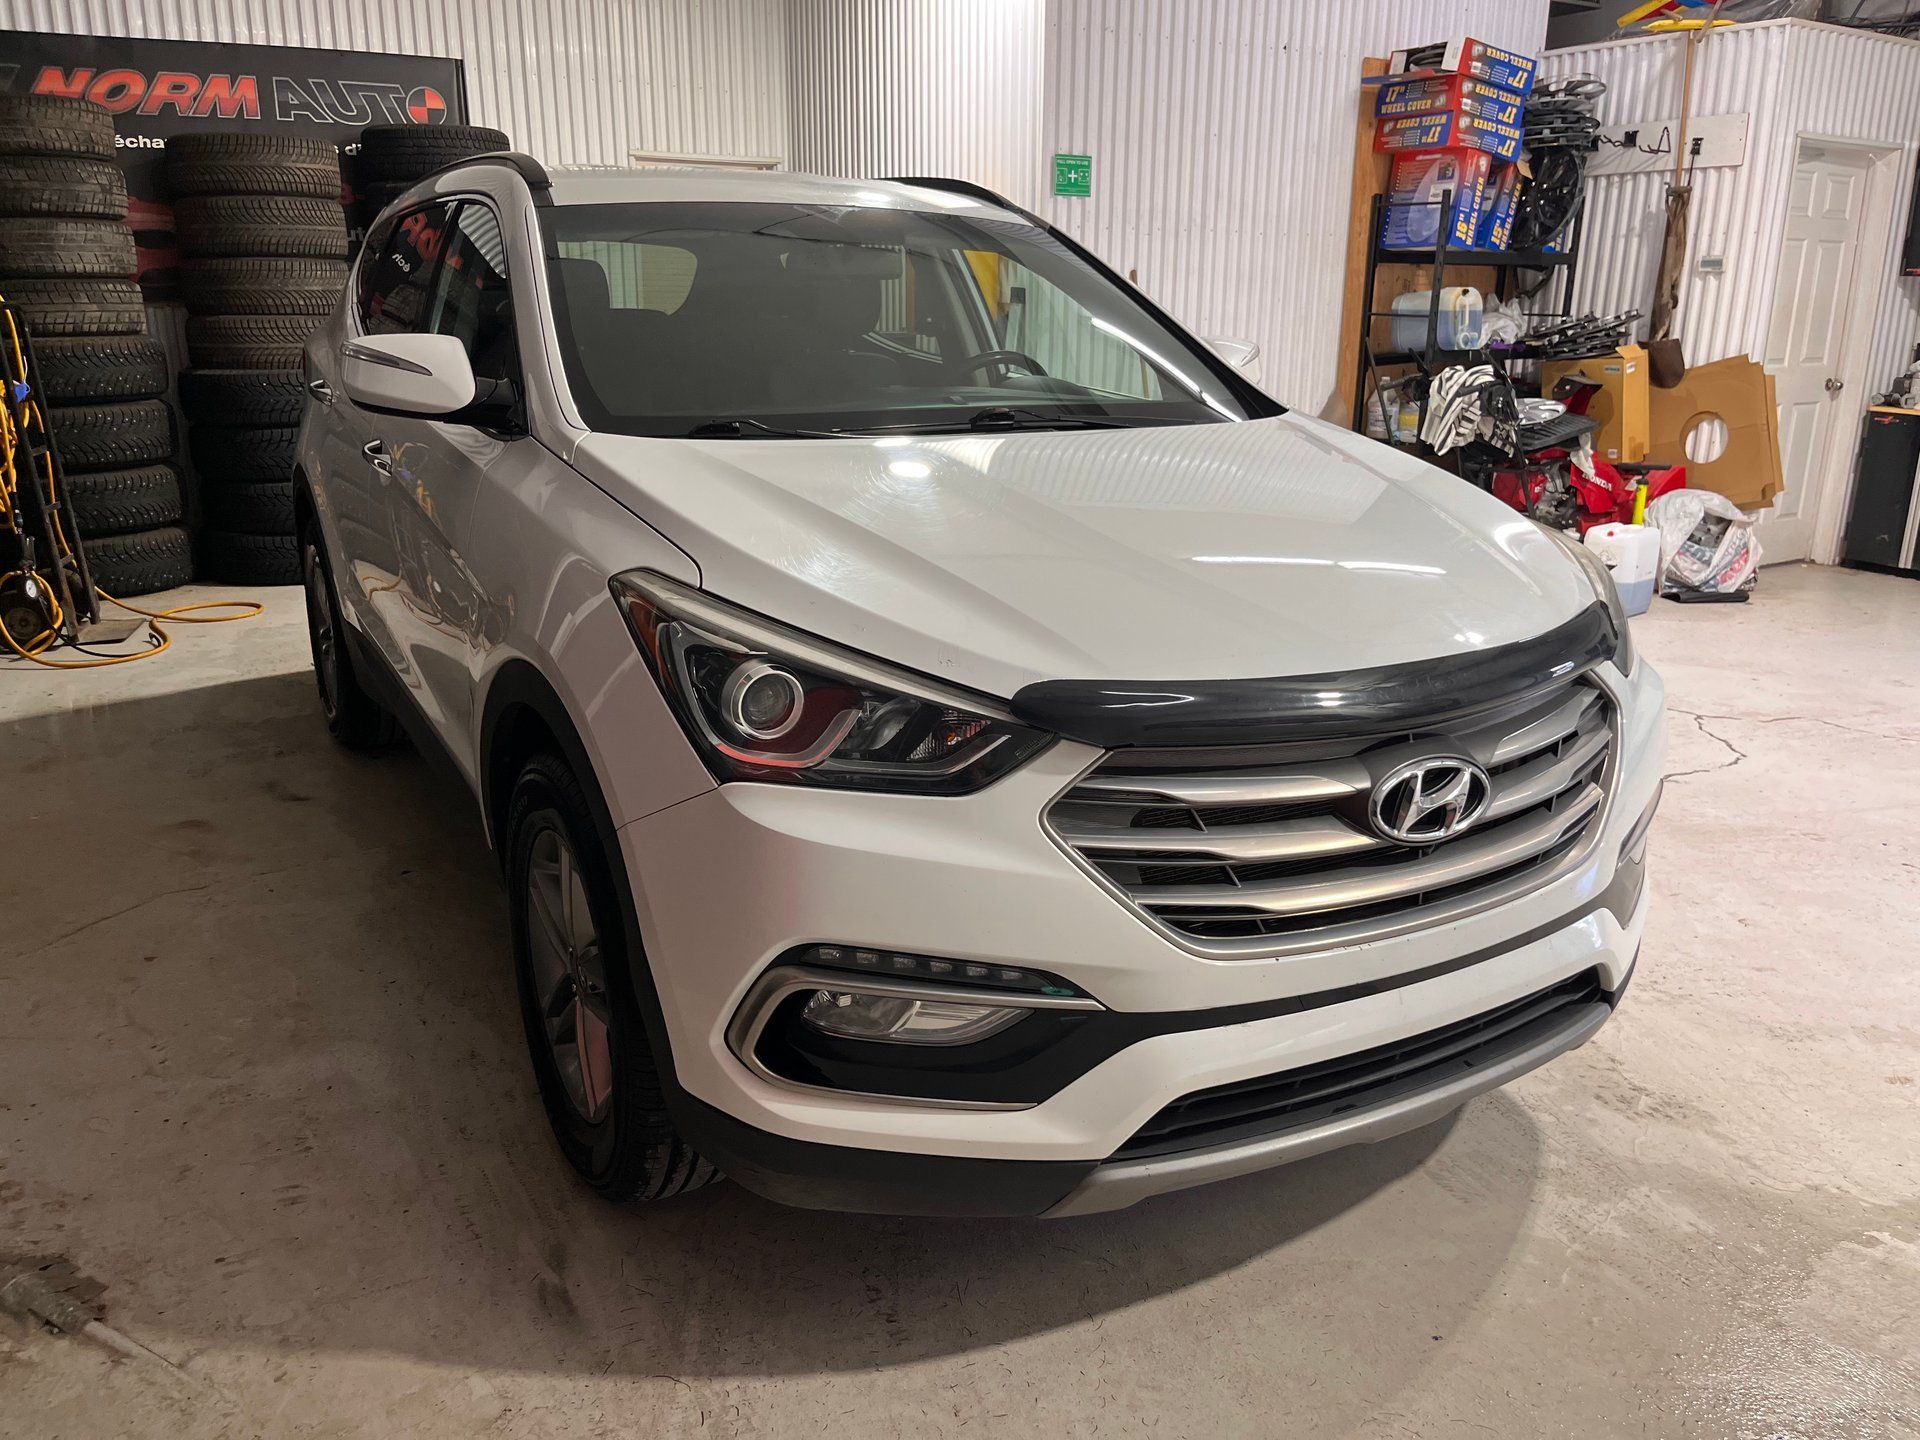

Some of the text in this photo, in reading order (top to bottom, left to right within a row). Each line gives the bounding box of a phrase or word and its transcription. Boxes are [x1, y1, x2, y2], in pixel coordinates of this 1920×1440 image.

[1486, 47, 1509, 62] COVER
[1509, 55, 1533, 71] WHEEL
[30, 65, 261, 119] NORM
[1475, 83, 1521, 106] WHEEL COVER
[1381, 99, 1432, 114] WHEEL COVER
[1396, 114, 1447, 129] WHEEL COVER
[1473, 118, 1520, 139] WHEEL COVER
[114, 134, 167, 149] écha
[1466, 211, 1478, 245] WHEEL
[1473, 176, 1484, 210] COVER
[1499, 217, 1513, 251] WHEEL
[1509, 182, 1522, 216] COVER
